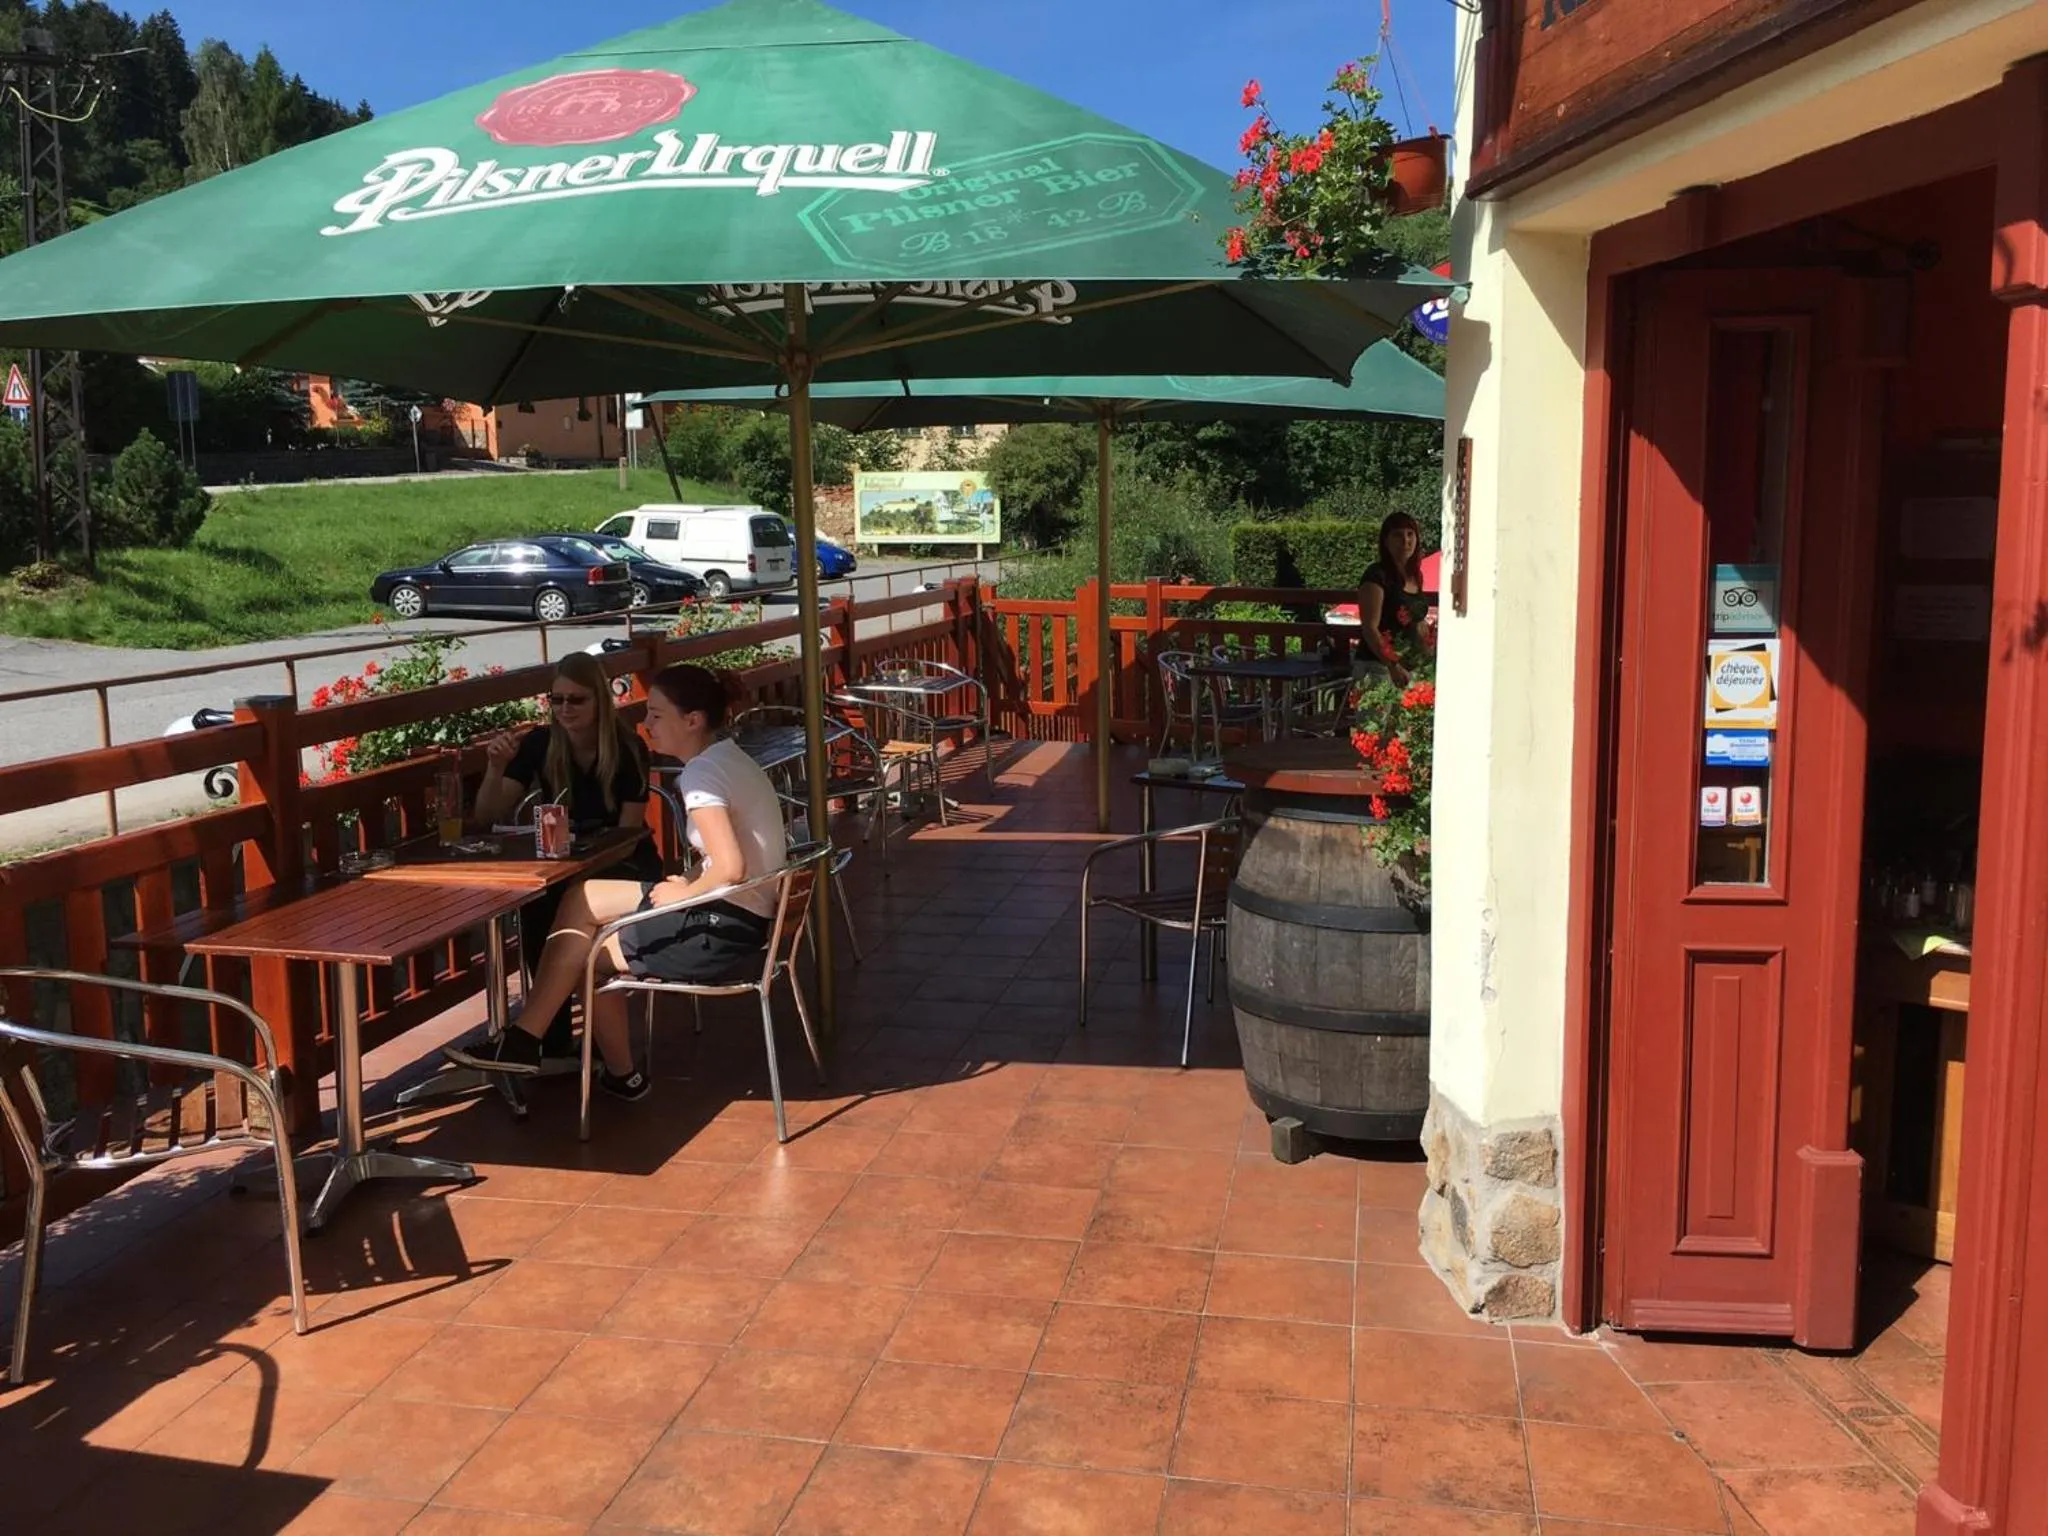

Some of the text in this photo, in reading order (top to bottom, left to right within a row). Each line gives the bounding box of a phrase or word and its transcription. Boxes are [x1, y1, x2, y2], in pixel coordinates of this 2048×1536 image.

[320, 147, 656, 236] Pilsner
[839, 161, 1141, 234] Pilsner Bier
[901, 157, 1064, 201] Original
[1715, 675, 1765, 687] déjeuner
[1720, 661, 1760, 676] chèque
